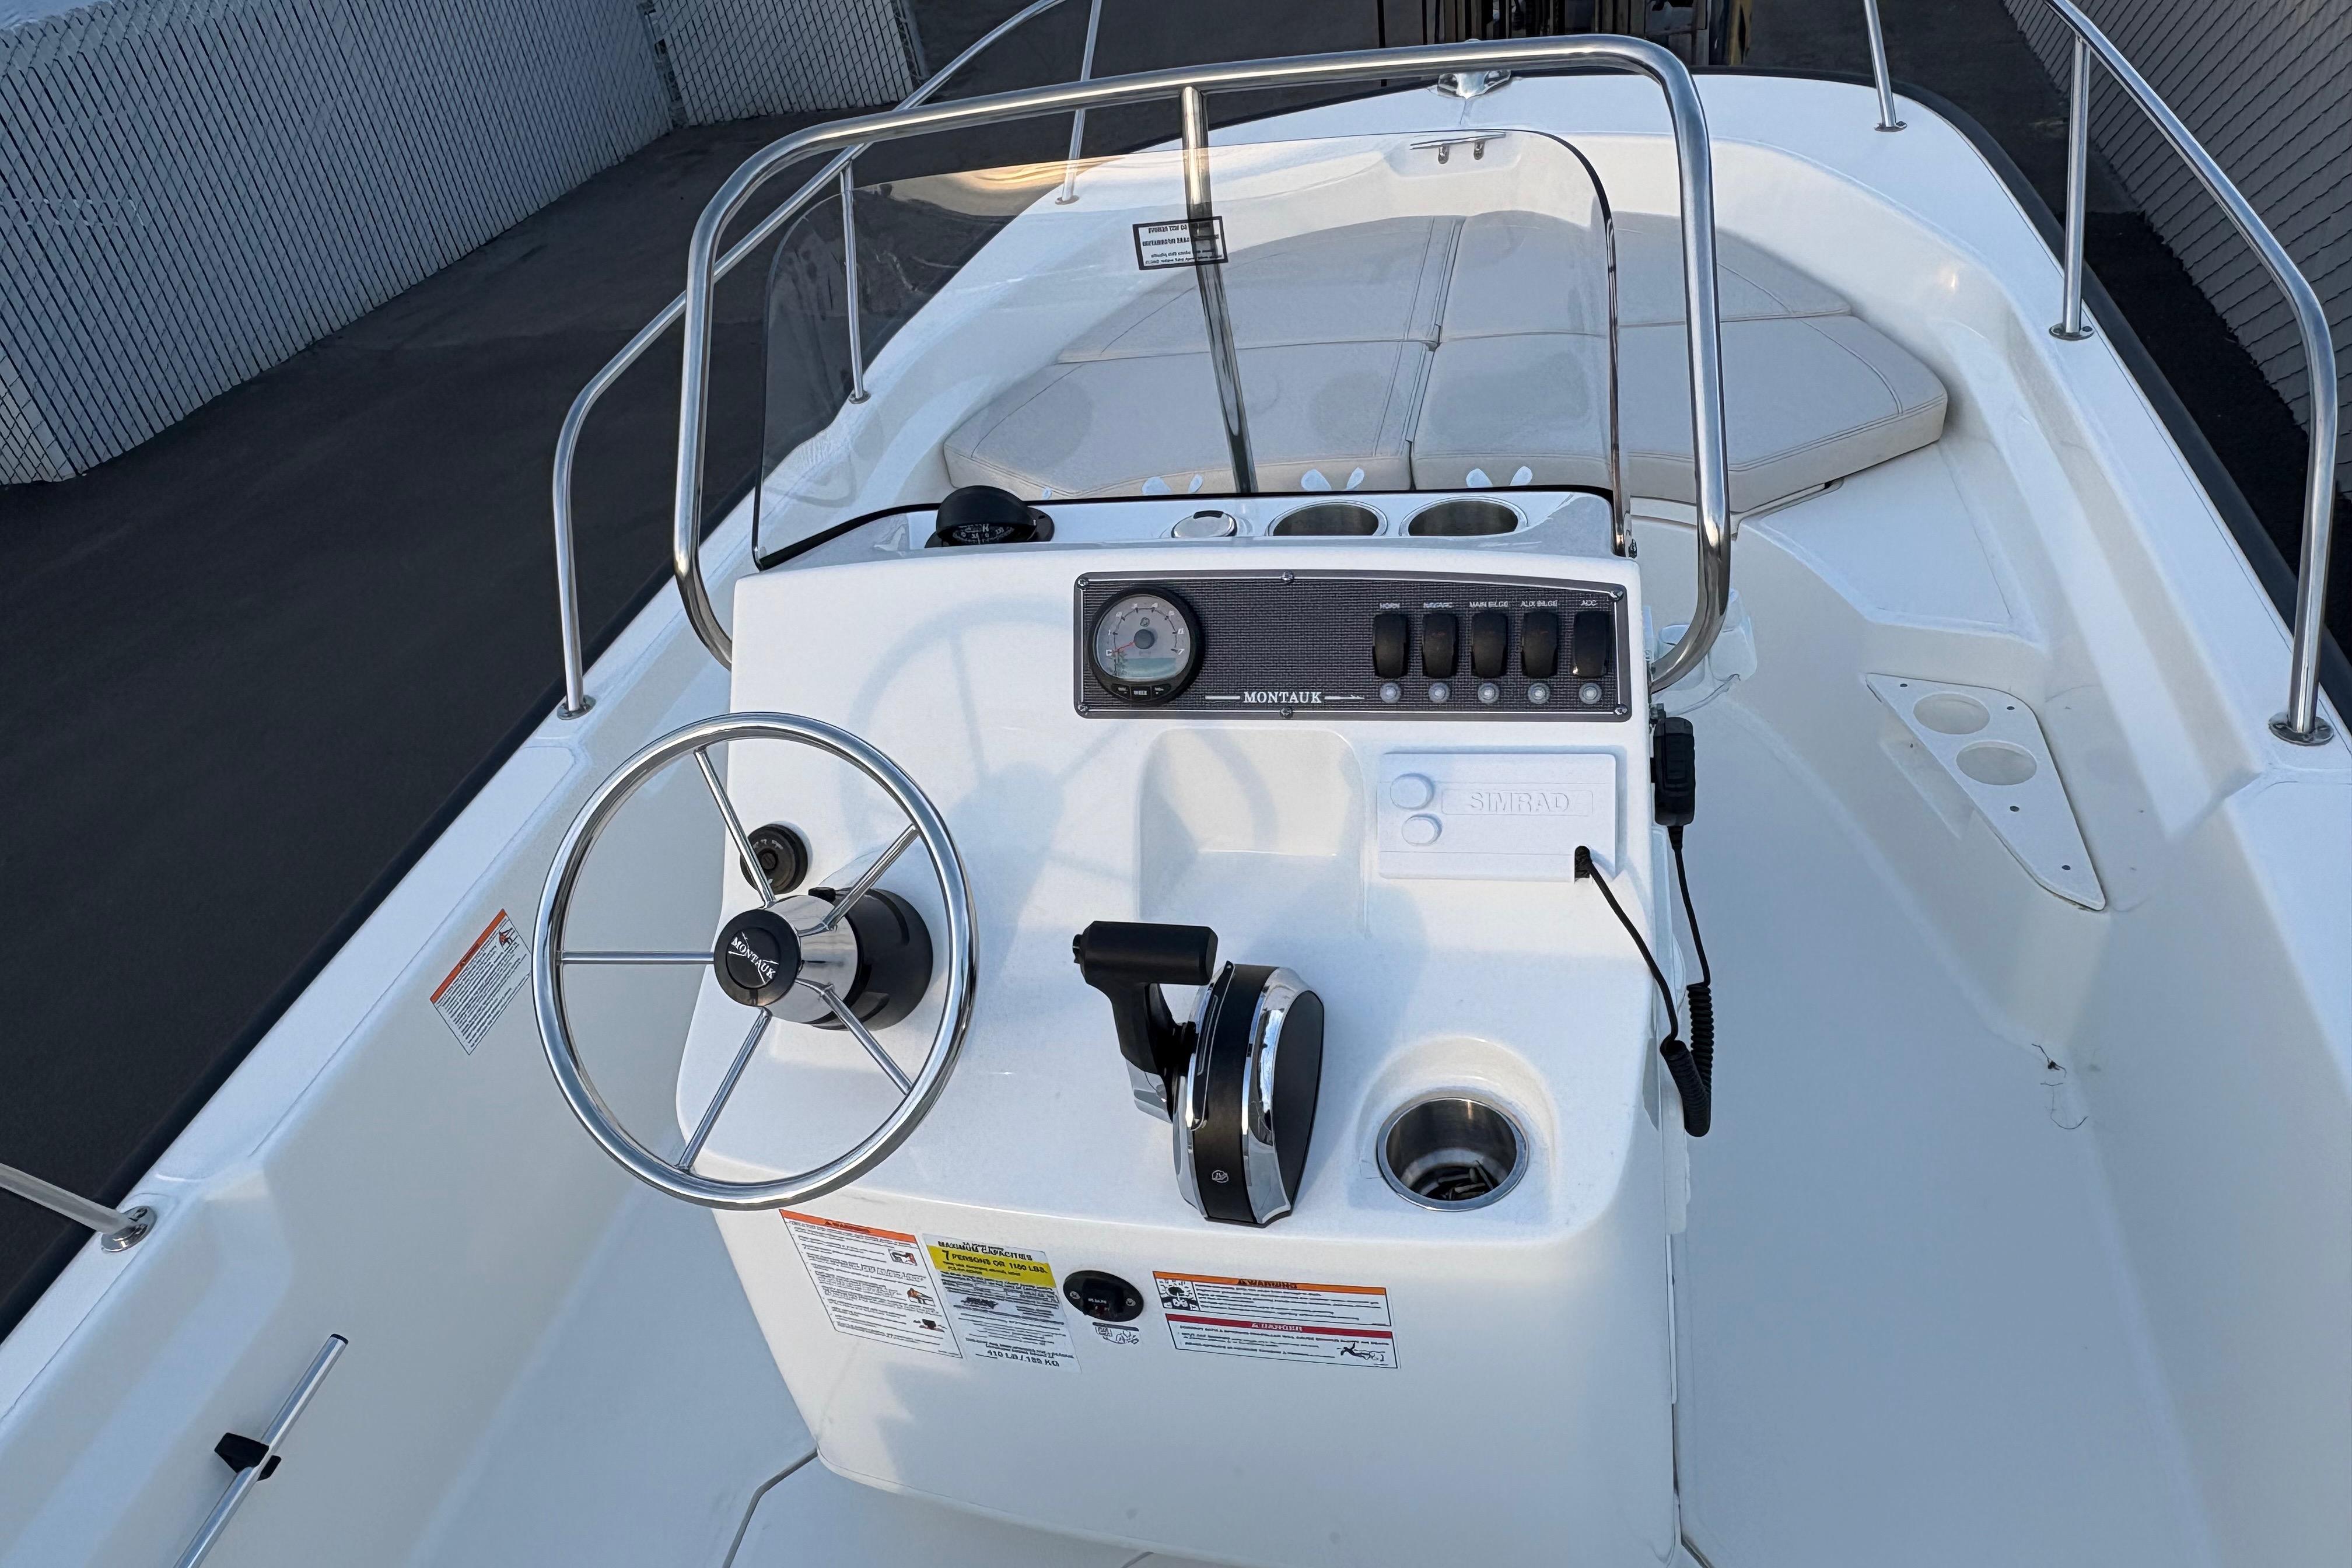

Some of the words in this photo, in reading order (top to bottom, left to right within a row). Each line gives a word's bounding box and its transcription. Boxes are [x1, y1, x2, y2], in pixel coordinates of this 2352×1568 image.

[1244, 691, 1322, 704] MONTAUK
[1469, 792, 1569, 813] SIMRAD
[731, 937, 776, 979] MONTAUK
[942, 1250, 949, 1261] 7
